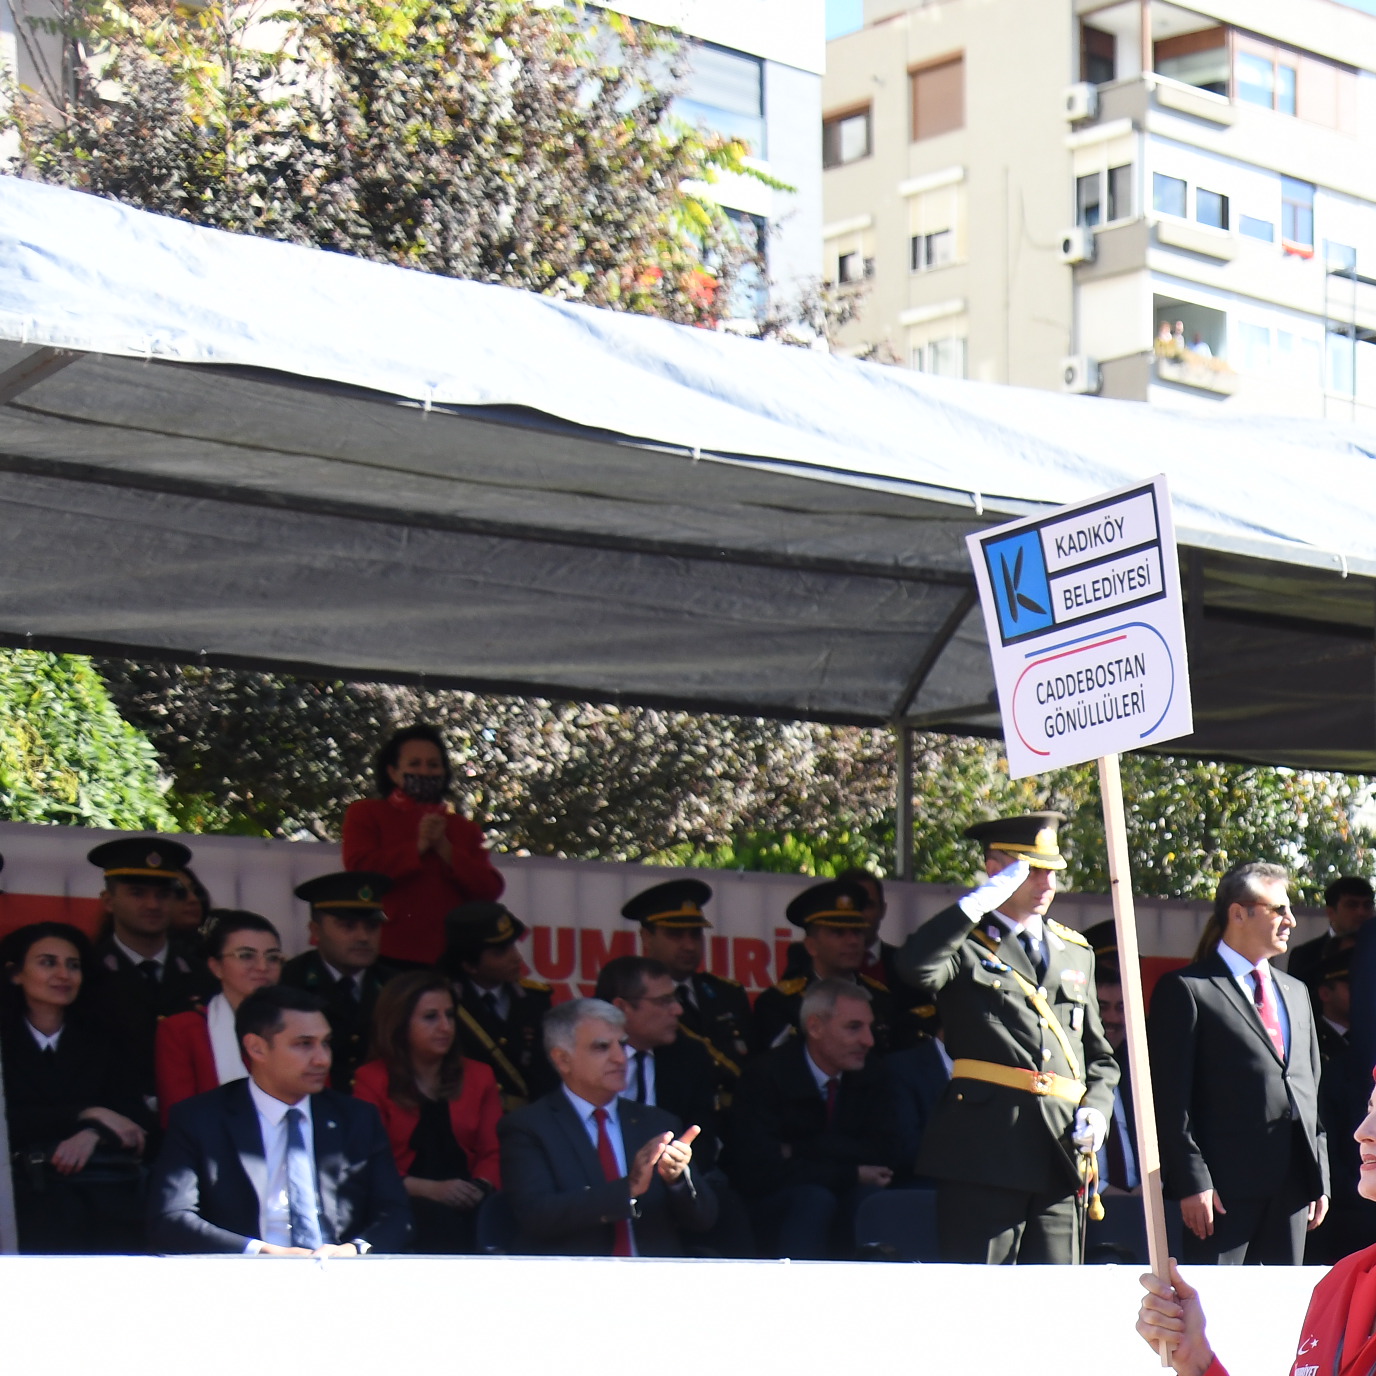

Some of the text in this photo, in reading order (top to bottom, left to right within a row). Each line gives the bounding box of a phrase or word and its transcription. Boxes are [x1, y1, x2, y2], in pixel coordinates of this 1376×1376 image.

[1055, 515, 1125, 559] KADIKÖY
[1063, 557, 1151, 611] BELEDİYESİ
[1036, 652, 1146, 706] CADDEBOSTAN
[1044, 683, 1146, 739] GÖNÜLLÜLERİ
